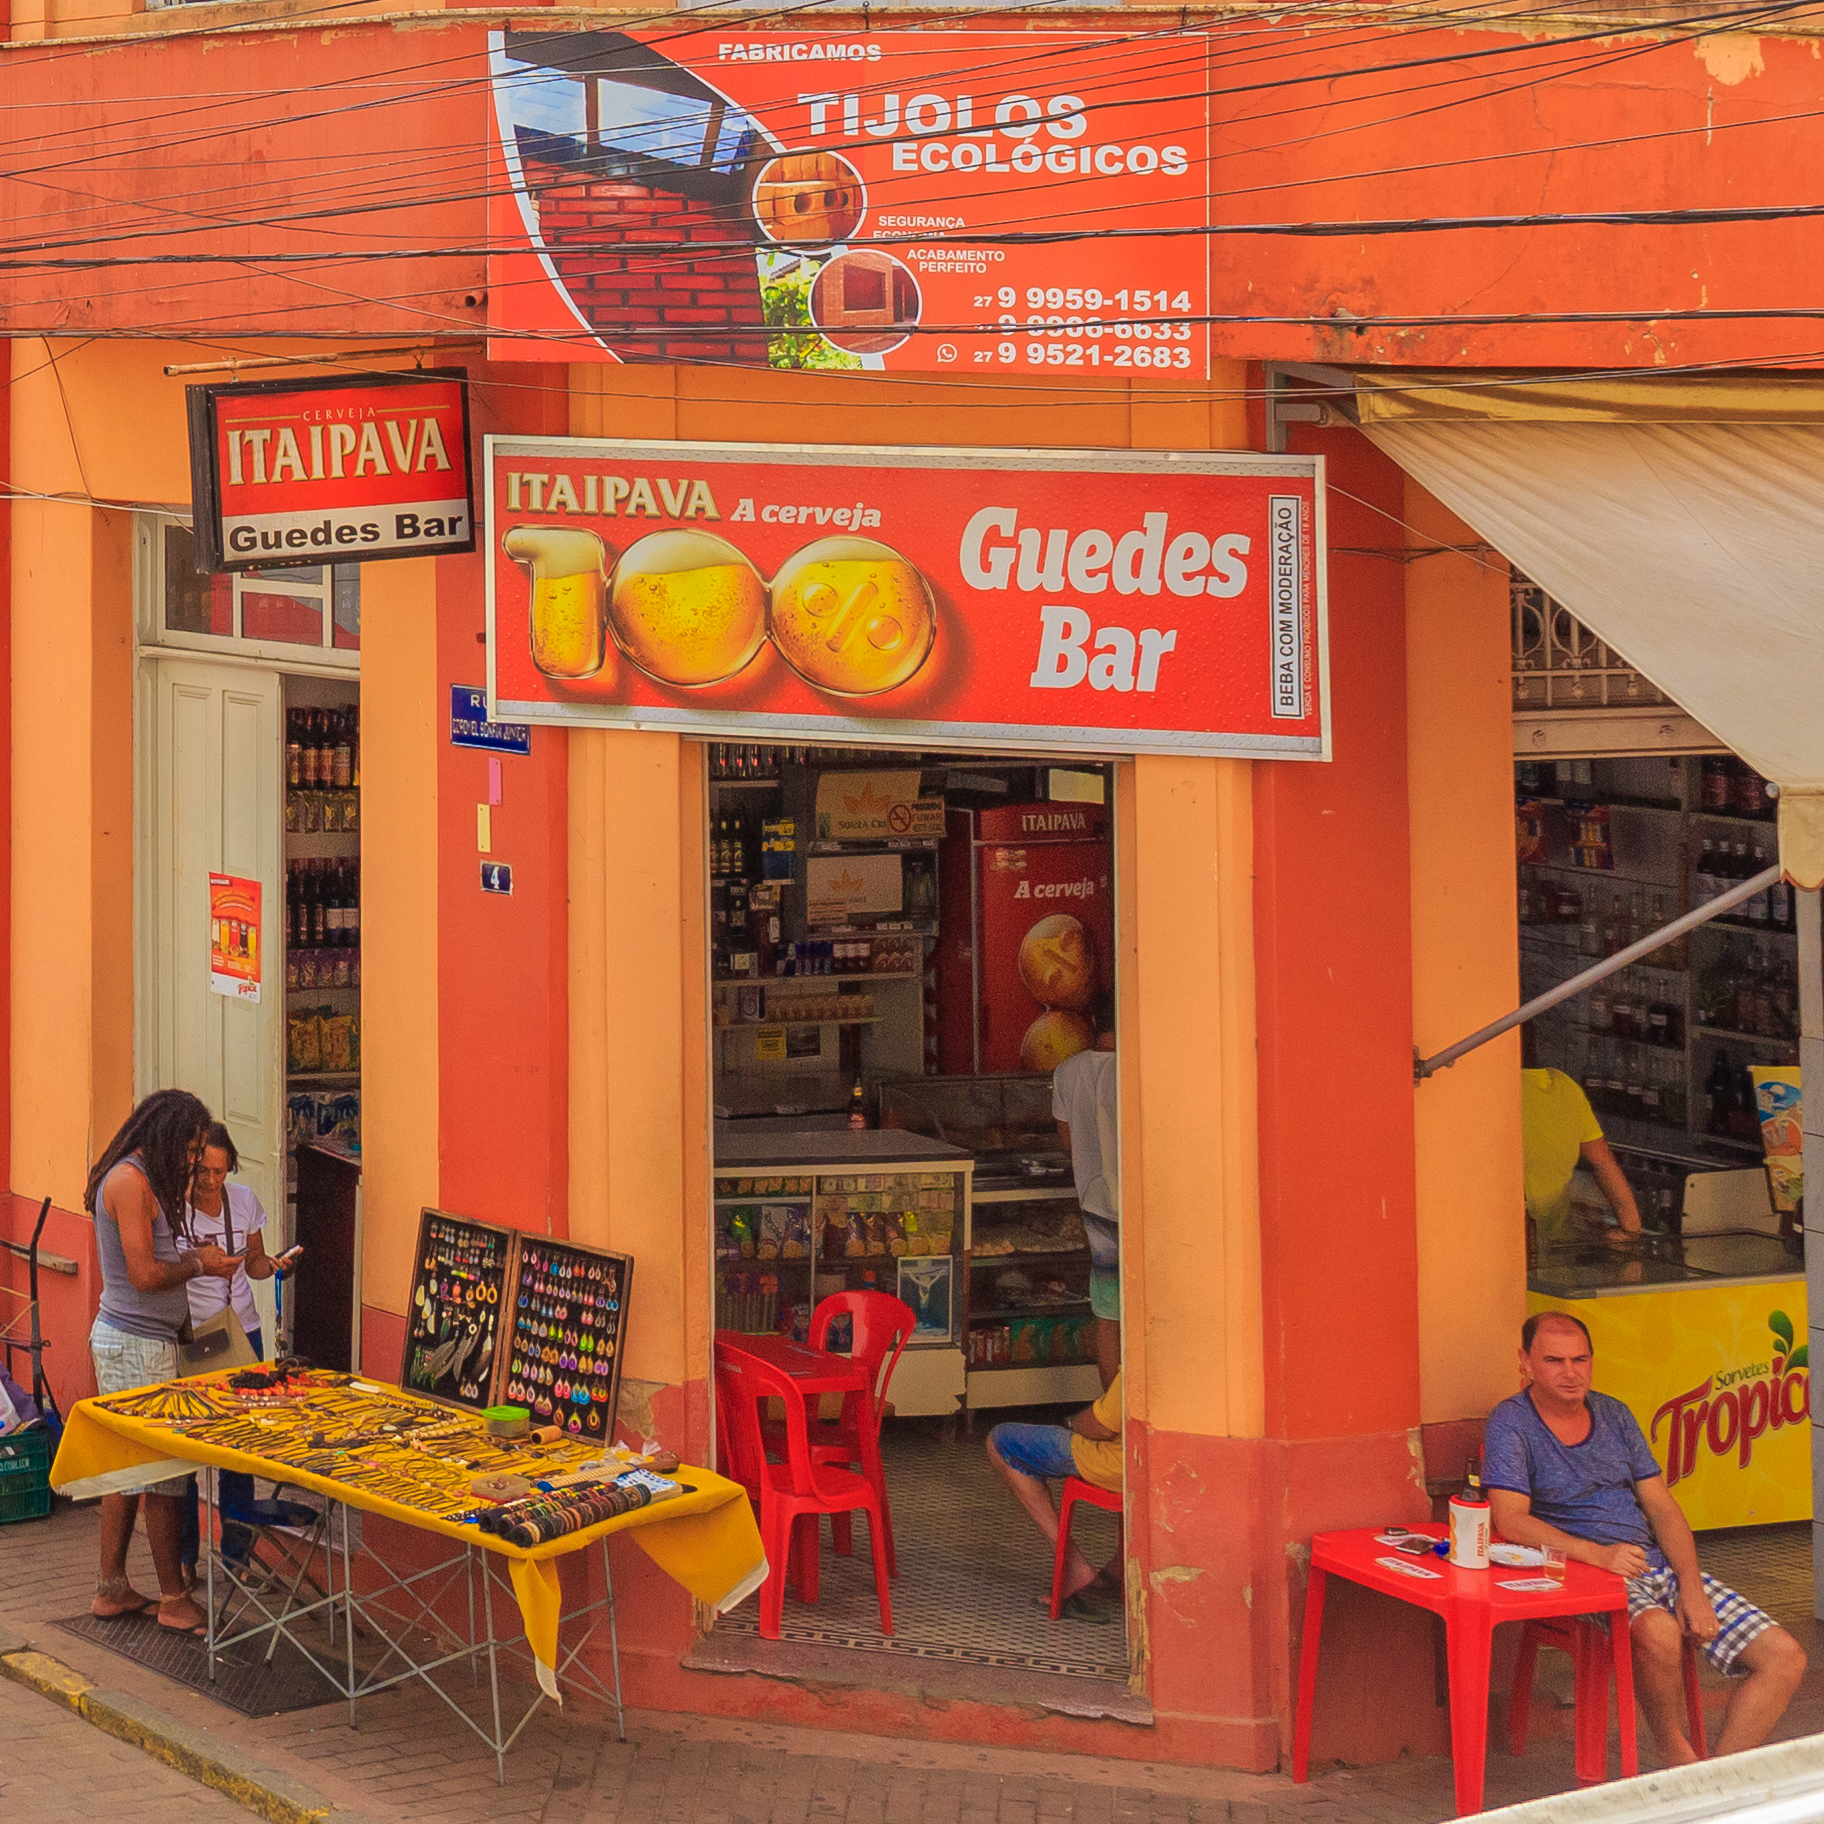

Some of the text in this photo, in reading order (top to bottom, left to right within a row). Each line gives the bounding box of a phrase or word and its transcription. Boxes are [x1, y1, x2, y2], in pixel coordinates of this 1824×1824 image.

[718, 43, 882, 63] FABRICAMOS
[797, 92, 1088, 140] TIJOLOS
[892, 136, 1189, 175] ECOLÓGICOS
[878, 215, 966, 229] SEGURANÇA
[906, 248, 1005, 262] ACABAMENTO
[919, 261, 987, 274] PERFEITO
[973, 286, 1192, 313] 27 9 9959-1514
[973, 341, 1192, 369] 27 9 9521-2683
[302, 406, 376, 422] CERVEJA
[226, 416, 453, 486] ITAIPAVA
[506, 472, 882, 529] ITAIPAVA A cerveja
[228, 512, 464, 553] Guedes Bar
[960, 506, 1252, 598] Guedes
[1274, 507, 1296, 707] BEBA COM MODERAÇÃO
[1030, 605, 1177, 694] Bar
[1021, 812, 1086, 832] ITAIPAVA
[490, 866, 501, 889] 4
[1014, 877, 1094, 899] A cerveja
[1714, 1361, 1770, 1391] Sorvetes
